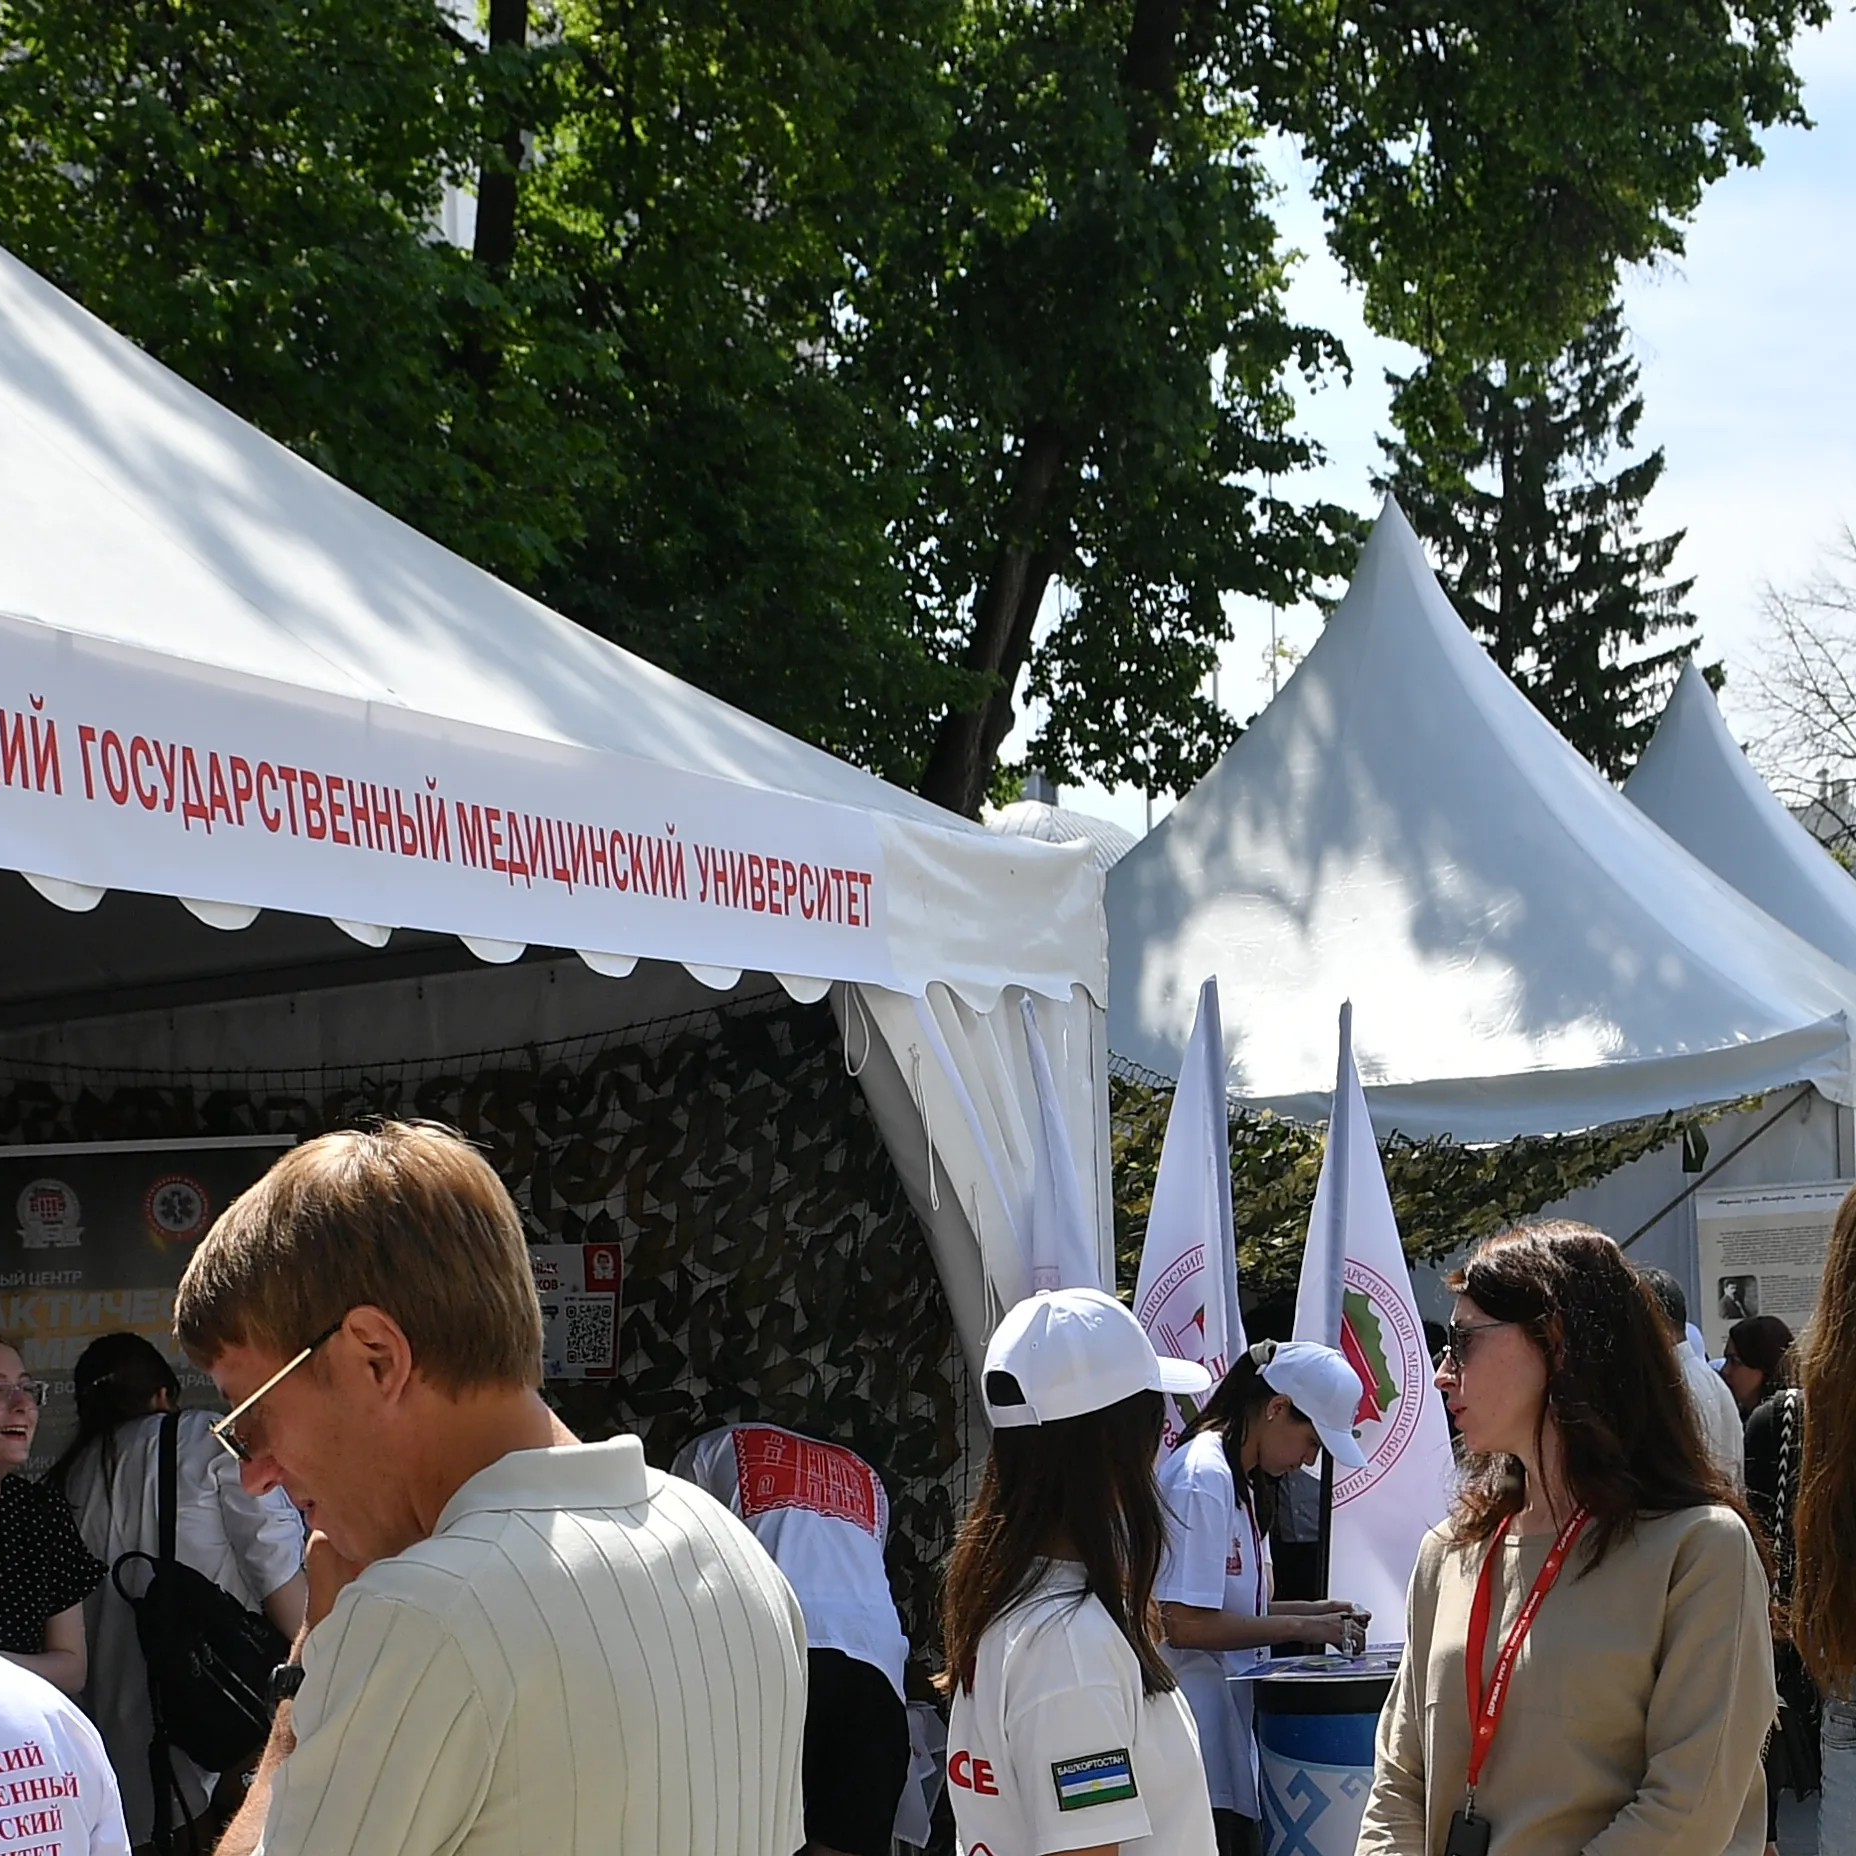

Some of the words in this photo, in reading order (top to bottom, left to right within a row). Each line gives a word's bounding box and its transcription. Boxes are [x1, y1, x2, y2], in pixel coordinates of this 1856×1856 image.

[77, 725, 451, 863] ГОСУДАРСТВЕННЫЙ
[455, 800, 687, 901] МЕДИЦИНСКИЙ
[693, 843, 873, 928] УНИВЕРСИТЕТ
[28, 1270, 83, 1287] ЦЕНТР
[1141, 1249, 1205, 1329] ШКИРСКИЙ
[1344, 1265, 1415, 1343] АРСТВЕННЫЙ
[1375, 1349, 1420, 1470] МЕДИЦИНСКИЙ
